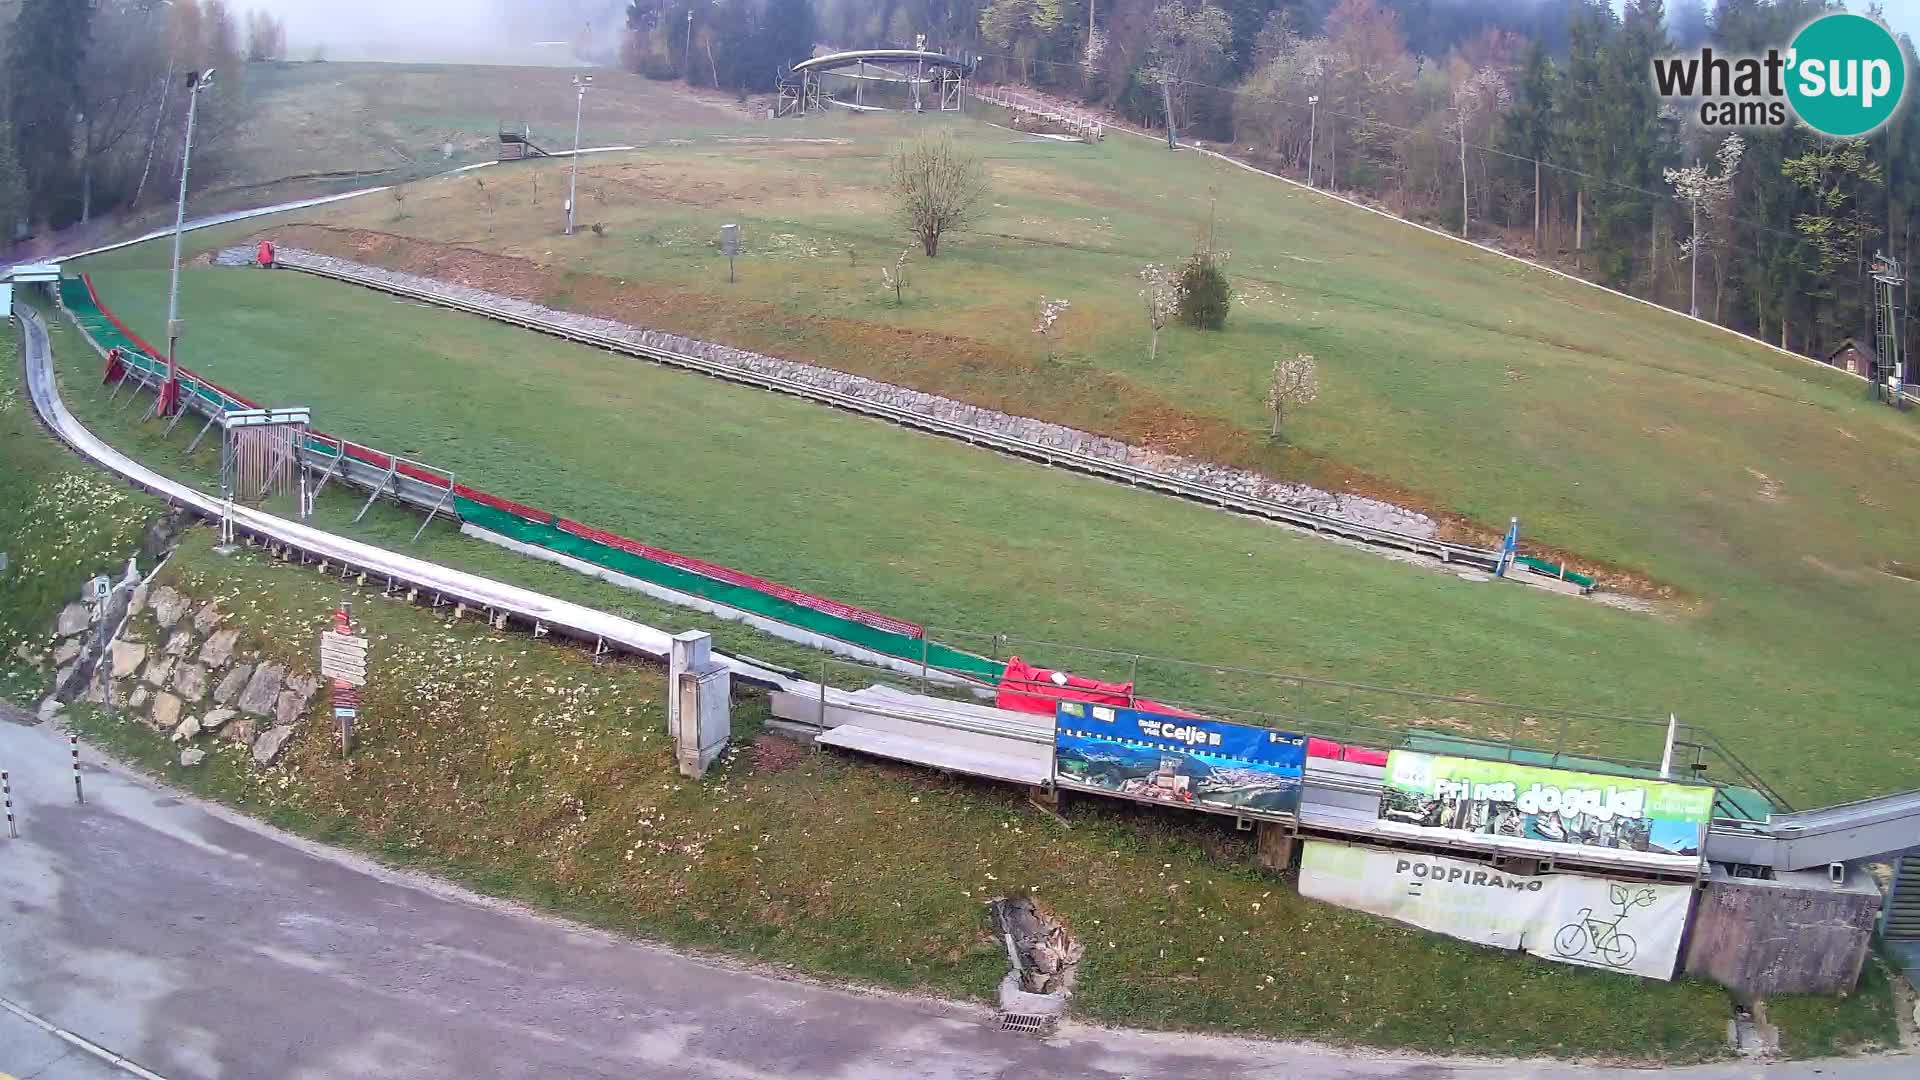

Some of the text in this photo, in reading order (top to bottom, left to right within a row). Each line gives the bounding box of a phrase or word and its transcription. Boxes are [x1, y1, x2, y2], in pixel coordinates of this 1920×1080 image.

[1161, 723, 1207, 745] Celje
[1434, 778, 1470, 801] Pri
[1396, 859, 1543, 892] PODPIRAMO
